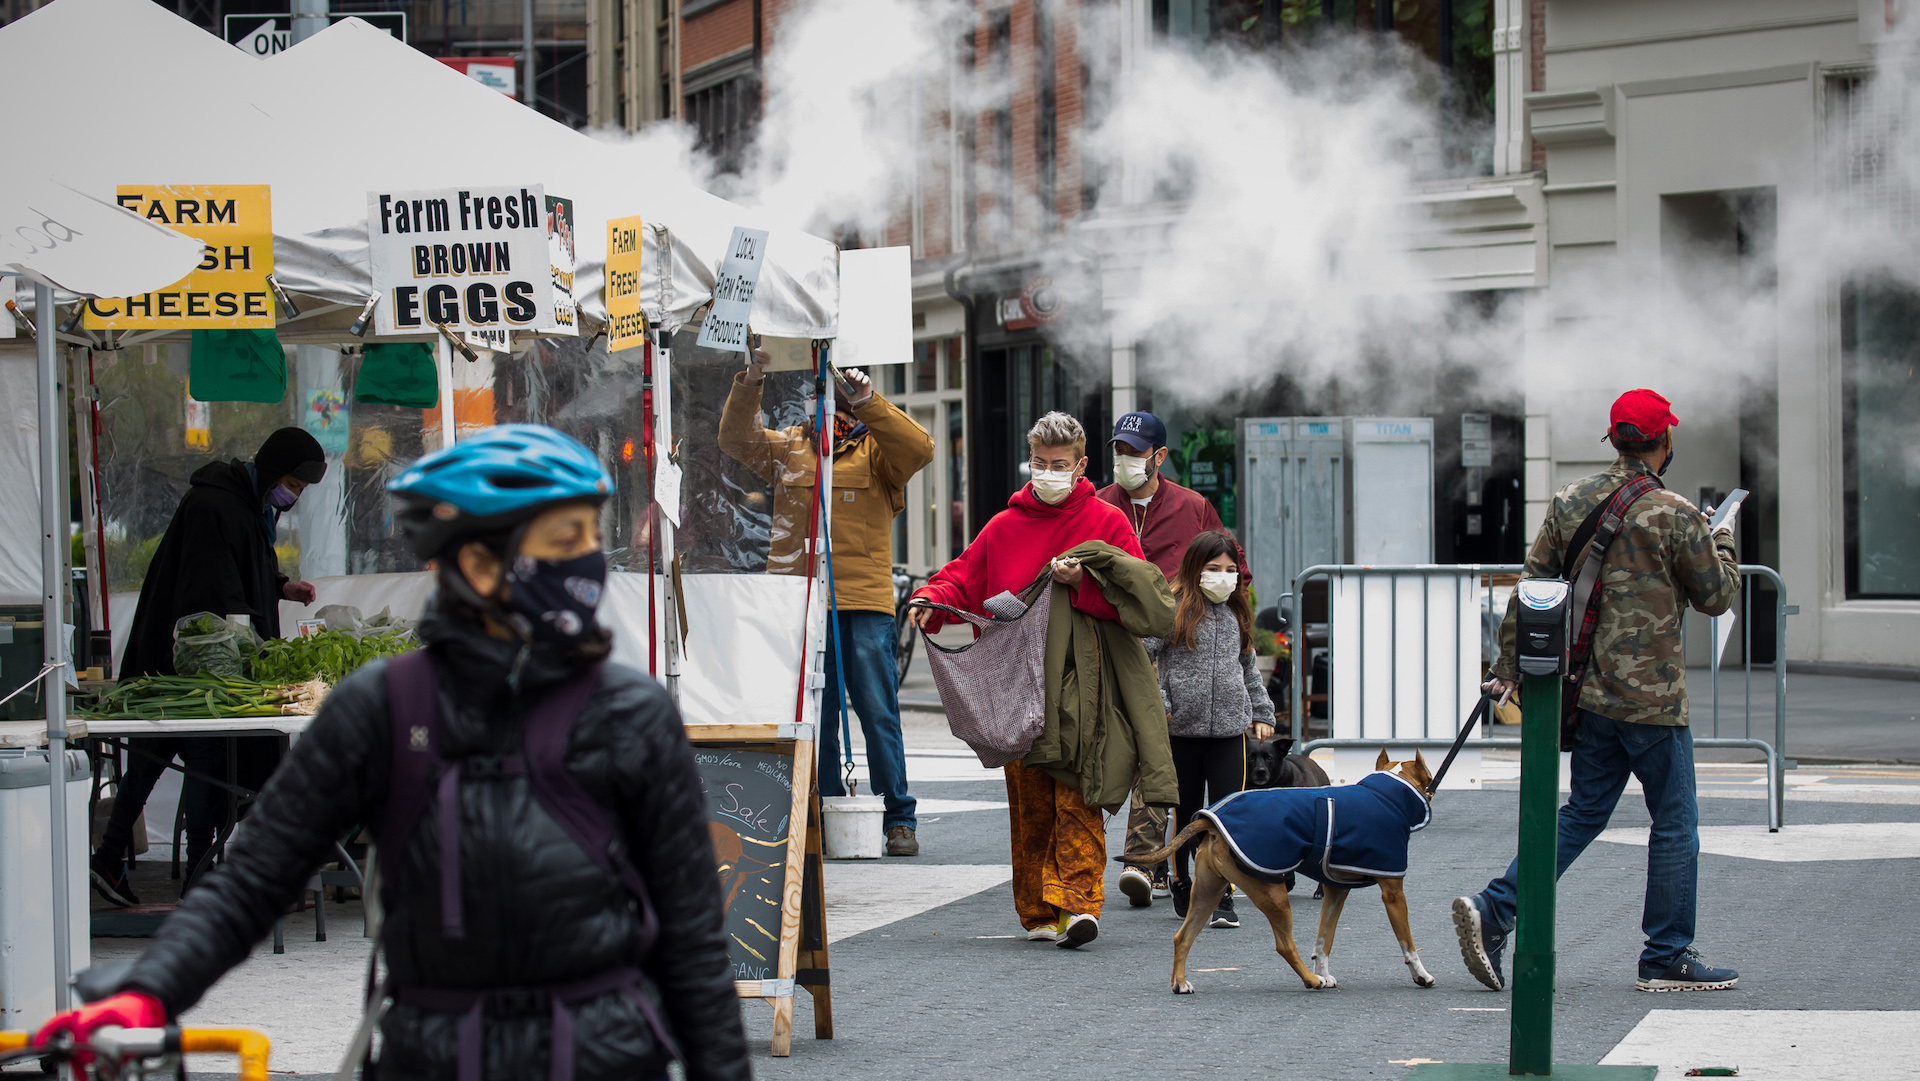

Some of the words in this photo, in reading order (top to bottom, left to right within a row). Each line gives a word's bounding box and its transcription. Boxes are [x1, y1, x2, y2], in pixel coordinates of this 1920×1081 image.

[255, 33, 291, 55] ON
[379, 193, 451, 234] Farm
[458, 188, 539, 231] Fresh
[612, 226, 636, 255] FARM
[735, 231, 758, 260] LOCAL
[412, 241, 511, 278] BROWN
[610, 269, 638, 298] FRESH
[716, 272, 736, 301] FARM
[733, 275, 757, 303] FRESH
[88, 291, 268, 318] CHEESE
[392, 281, 537, 330] EGGS
[707, 314, 743, 345] PRODUCE
[1259, 424, 1279, 435] TITAN
[1309, 423, 1329, 435] TITAN
[1376, 423, 1411, 435] TITAN
[776, 760, 789, 771] NO
